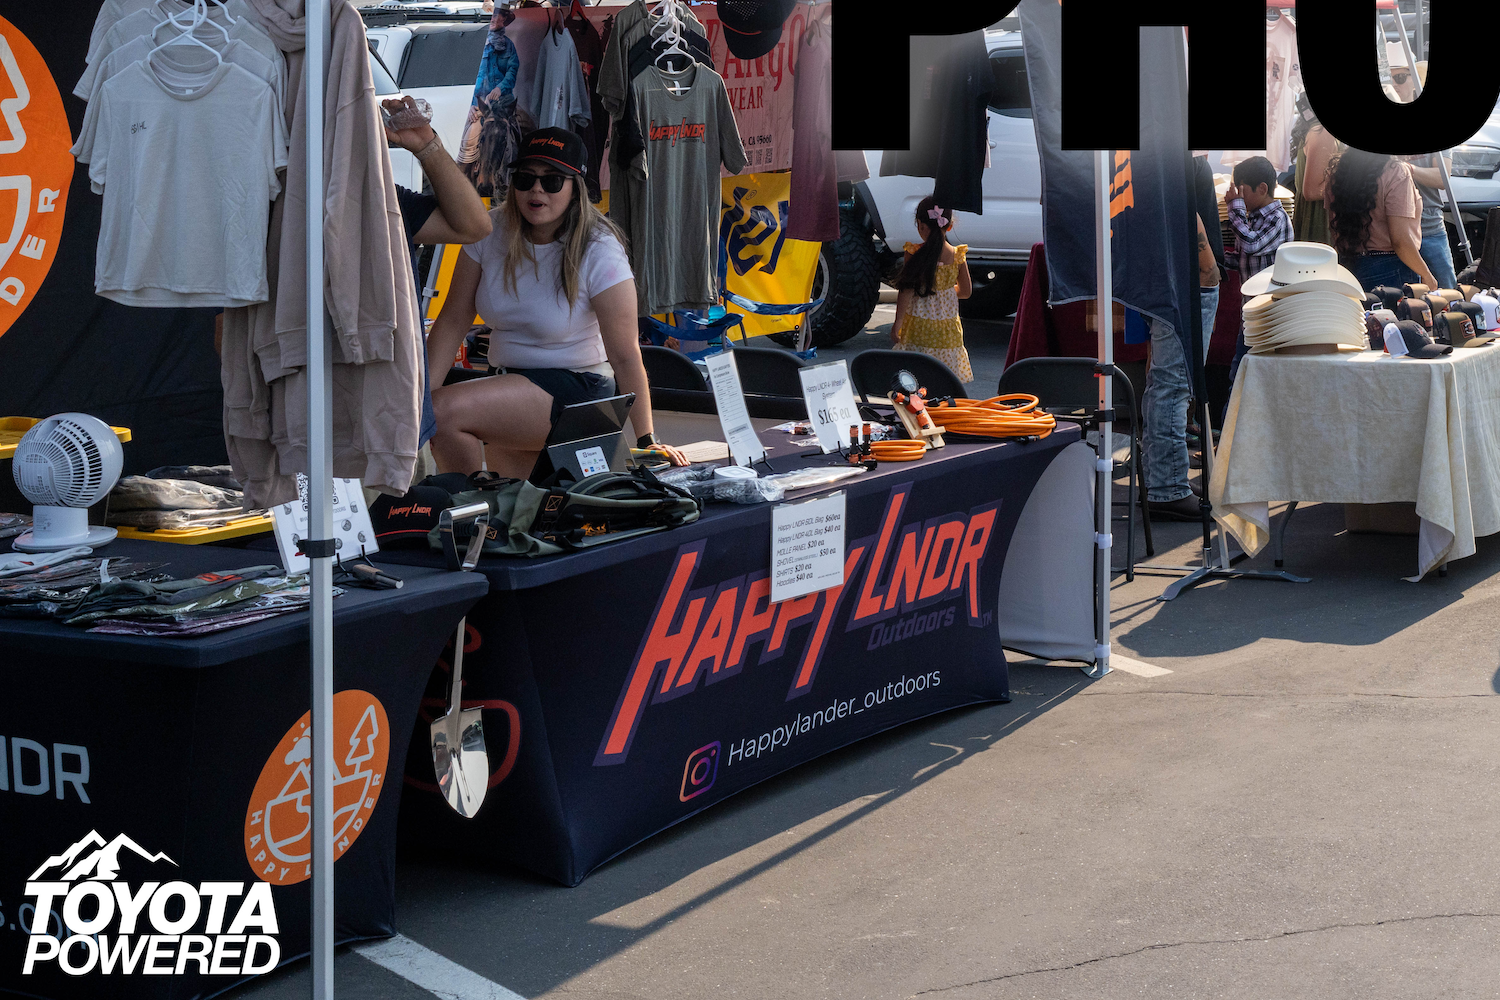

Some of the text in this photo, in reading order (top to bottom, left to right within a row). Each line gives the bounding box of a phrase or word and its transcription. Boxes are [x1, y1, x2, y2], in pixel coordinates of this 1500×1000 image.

[649, 117, 706, 147] HAPPY LNDR
[0, 187, 60, 307] DER
[817, 406, 852, 427] $165 ea
[388, 503, 433, 519] HAPPY LNDR
[777, 523, 793, 532] Happy
[792, 519, 805, 529] LNDR
[814, 516, 825, 525] Bag
[777, 535, 793, 544] Happy
[792, 531, 805, 541] LNDR
[814, 527, 824, 536] Bag
[823, 525, 834, 535] $40
[833, 524, 842, 532] ea
[776, 546, 793, 557] MOLLE
[792, 542, 807, 553] PANEL
[807, 540, 818, 549] $20
[776, 556, 794, 568] SHOVEL
[819, 548, 829, 558] $50
[829, 547, 837, 555] ea
[776, 562, 812, 579] SHIRTS $20 ea
[776, 577, 796, 588] Hoodies
[795, 572, 806, 583] $40
[805, 571, 814, 580] ea
[601, 491, 998, 757] HAPPY LNDR
[866, 605, 956, 653] Outdoors
[726, 668, 942, 768] Happylander_outdoors
[0, 735, 92, 804] DR
[250, 771, 384, 882] HAPPY LNDER
